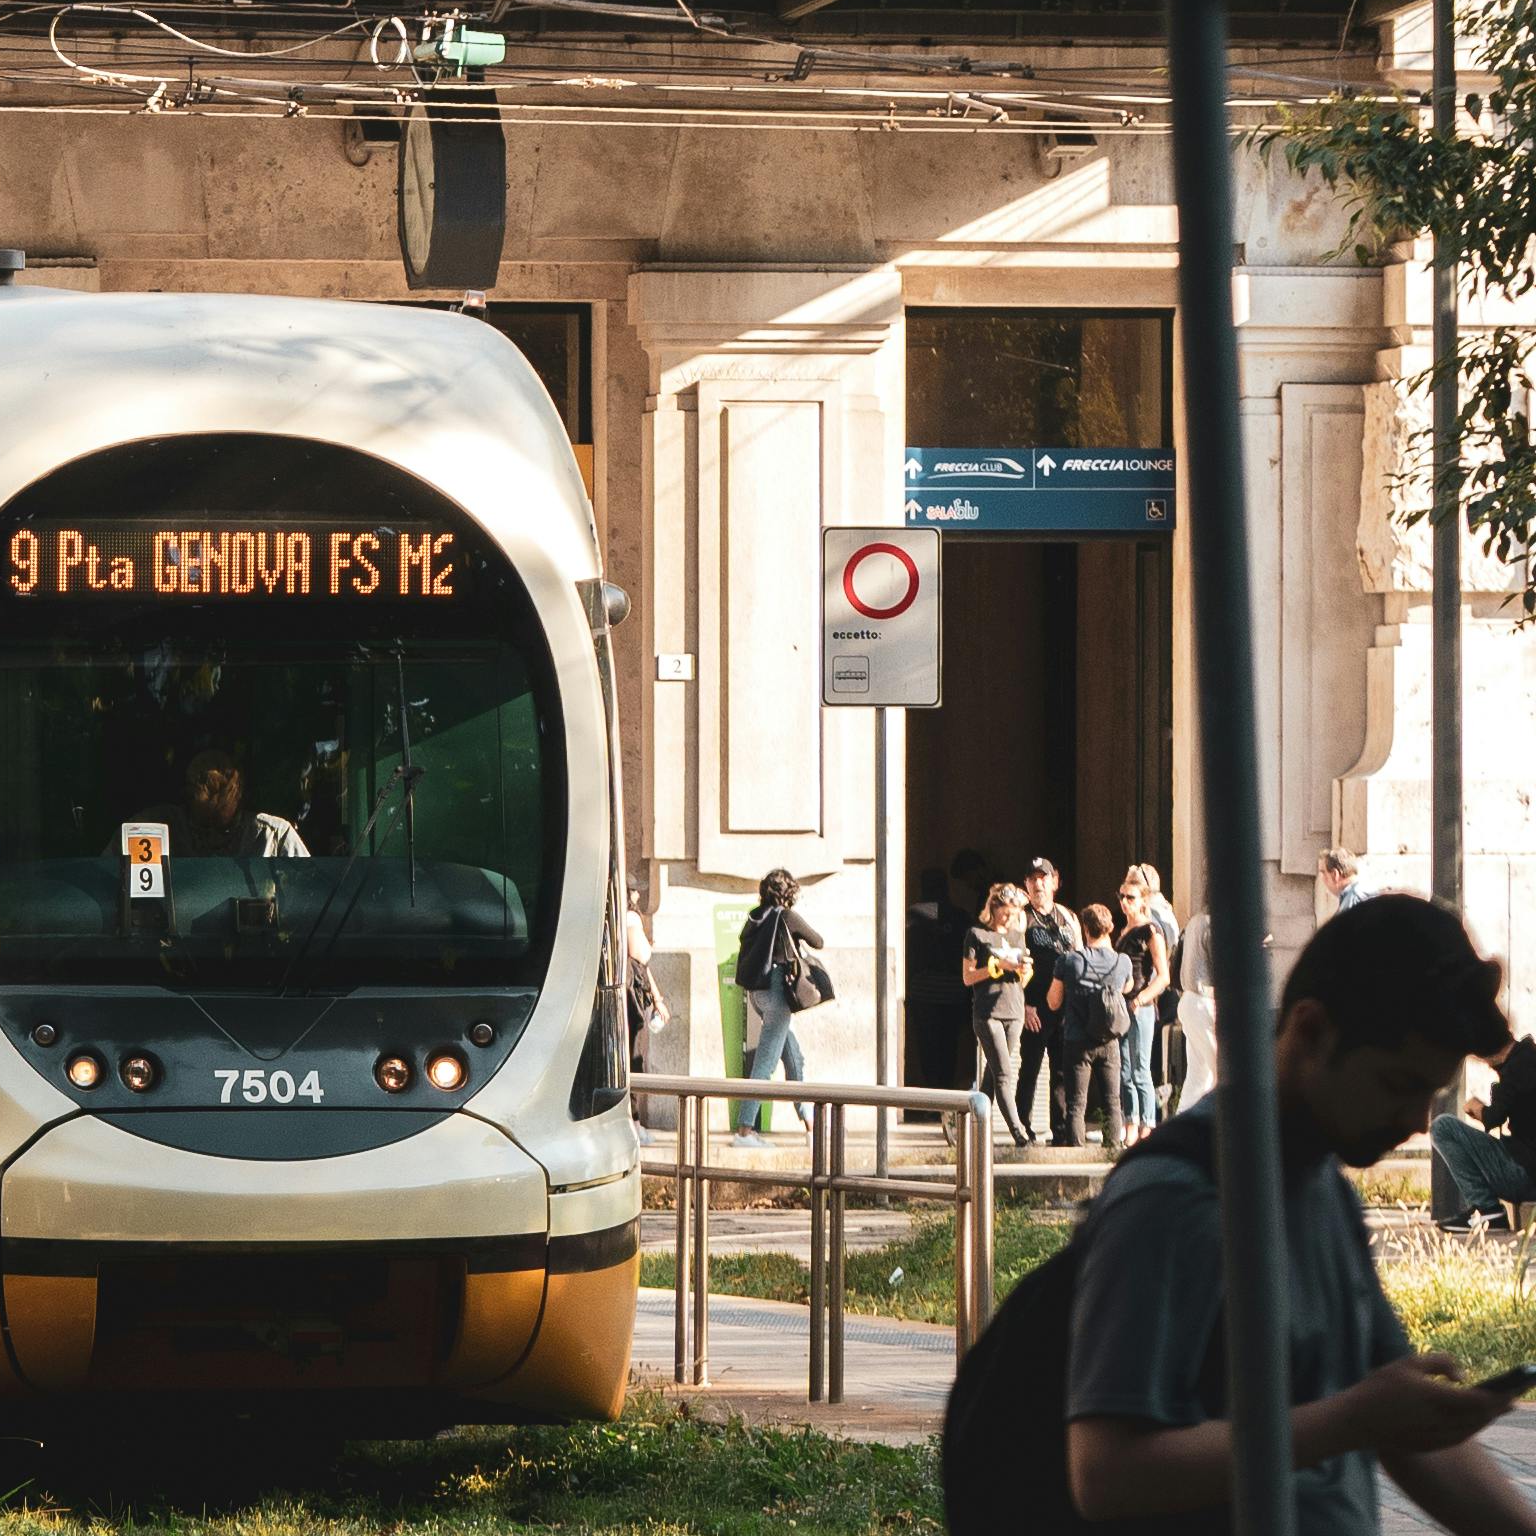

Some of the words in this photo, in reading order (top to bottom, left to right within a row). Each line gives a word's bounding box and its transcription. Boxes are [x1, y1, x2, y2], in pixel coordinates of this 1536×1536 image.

[10, 529, 38, 592] 9
[58, 530, 134, 592] Pta
[153, 531, 312, 594] GENOVA
[330, 532, 380, 595] FS
[399, 532, 454, 596] M2
[832, 629, 882, 640] eccetto:
[672, 658, 682, 674] 2
[138, 838, 153, 862] 3
[139, 867, 153, 892] 9
[214, 1069, 325, 1104] 7504
